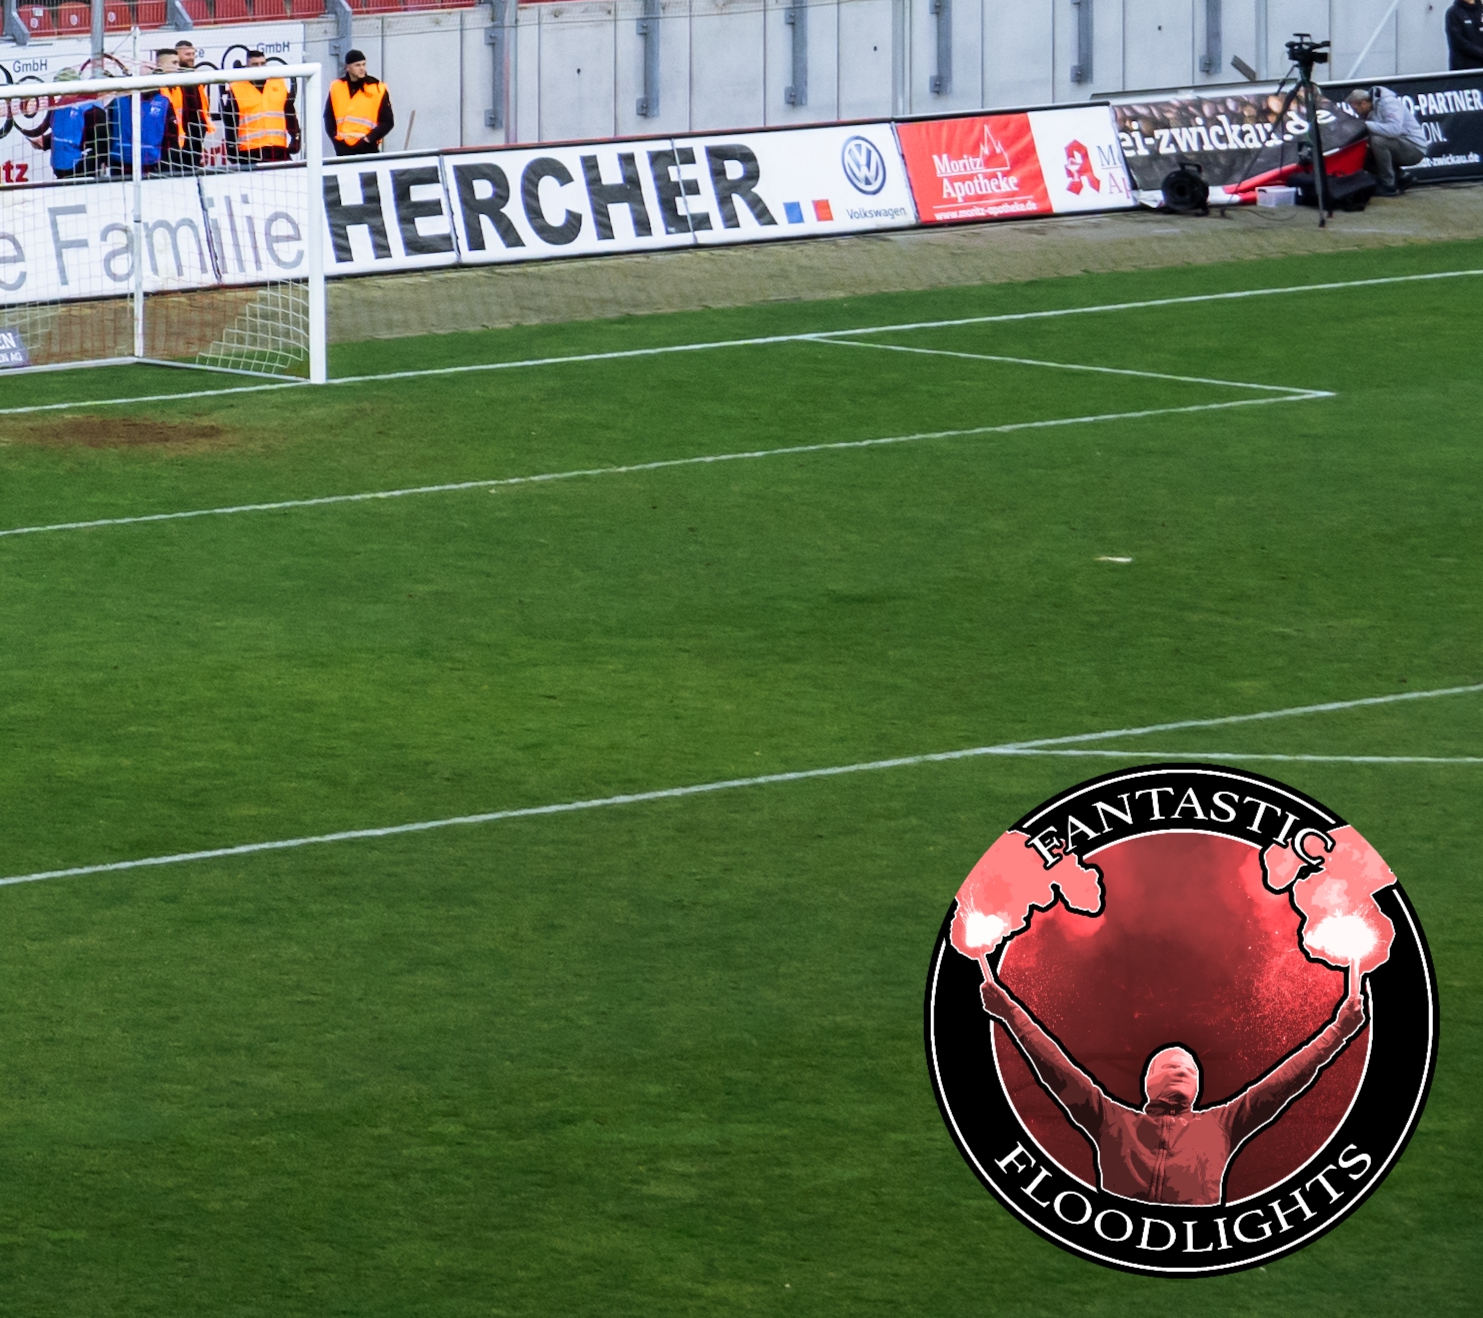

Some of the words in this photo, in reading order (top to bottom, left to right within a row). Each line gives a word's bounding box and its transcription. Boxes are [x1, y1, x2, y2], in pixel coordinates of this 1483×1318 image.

[255, 41, 291, 56] GmbH
[12, 58, 48, 74] GmbH
[932, 152, 984, 175] Moritz
[941, 174, 1019, 203] Apotheke
[322, 143, 778, 264] HERCHER
[846, 202, 907, 222] Volkswagen
[47, 193, 305, 287] Familie
[10, 351, 23, 362] AG
